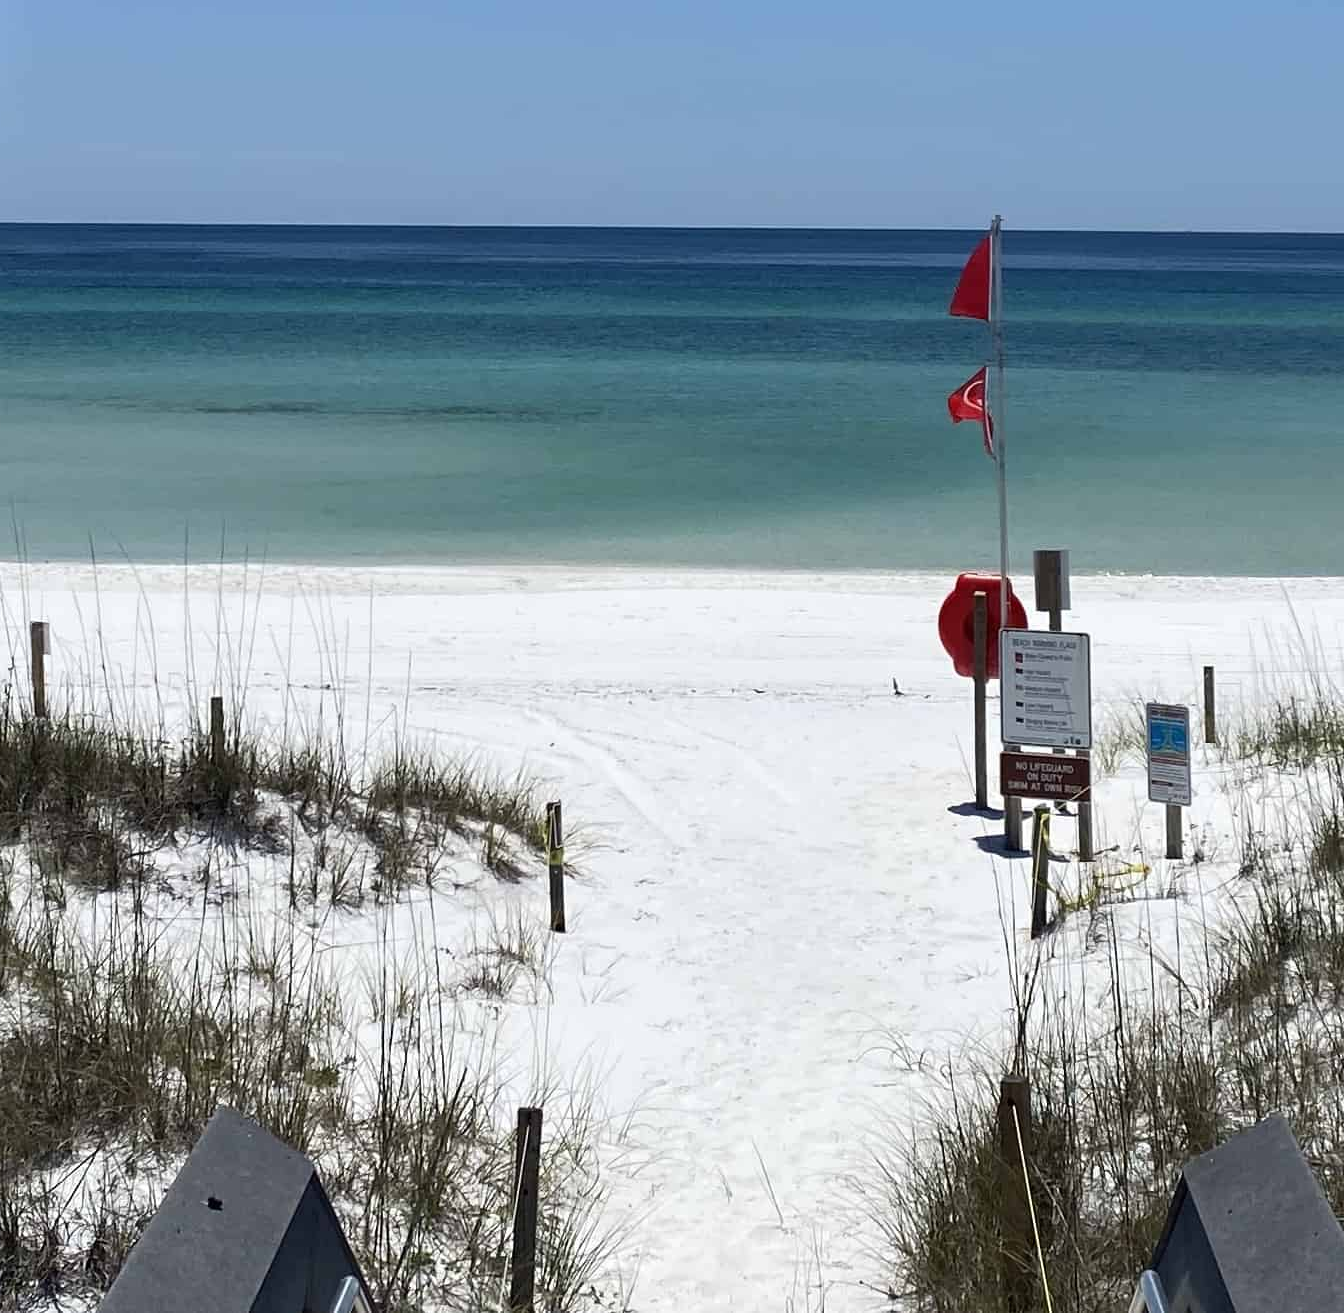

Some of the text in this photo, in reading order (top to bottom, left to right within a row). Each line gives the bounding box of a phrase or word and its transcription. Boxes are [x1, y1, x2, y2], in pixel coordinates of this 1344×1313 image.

[1016, 762, 1074, 773] NO LIFEGUARD
[1027, 773, 1063, 782] ON DUTY
[1008, 781, 1028, 789] SWIM
[1031, 783, 1041, 791] AT
[1045, 784, 1062, 792] OWN
